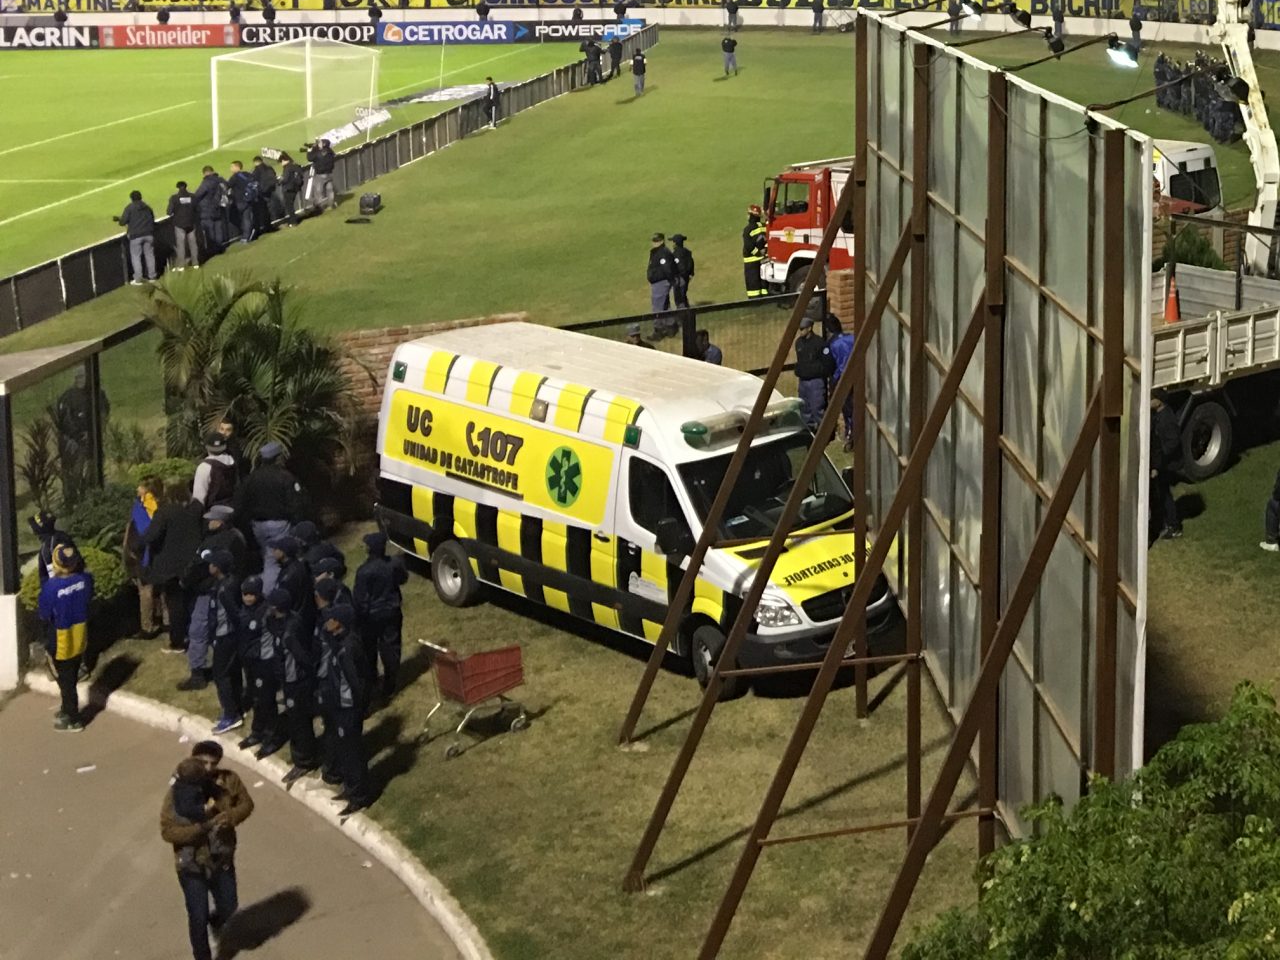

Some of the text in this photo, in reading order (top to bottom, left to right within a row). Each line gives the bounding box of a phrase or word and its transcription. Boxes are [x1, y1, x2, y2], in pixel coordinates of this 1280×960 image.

[126, 25, 211, 46] Schneider
[241, 24, 376, 43] CREDICOOP
[402, 24, 507, 41] CETROGAR
[535, 24, 642, 37] POWERADE
[406, 405, 433, 437] UC
[477, 426, 524, 466] 107
[403, 439, 519, 490] UNIDAD DE CATASTROFE
